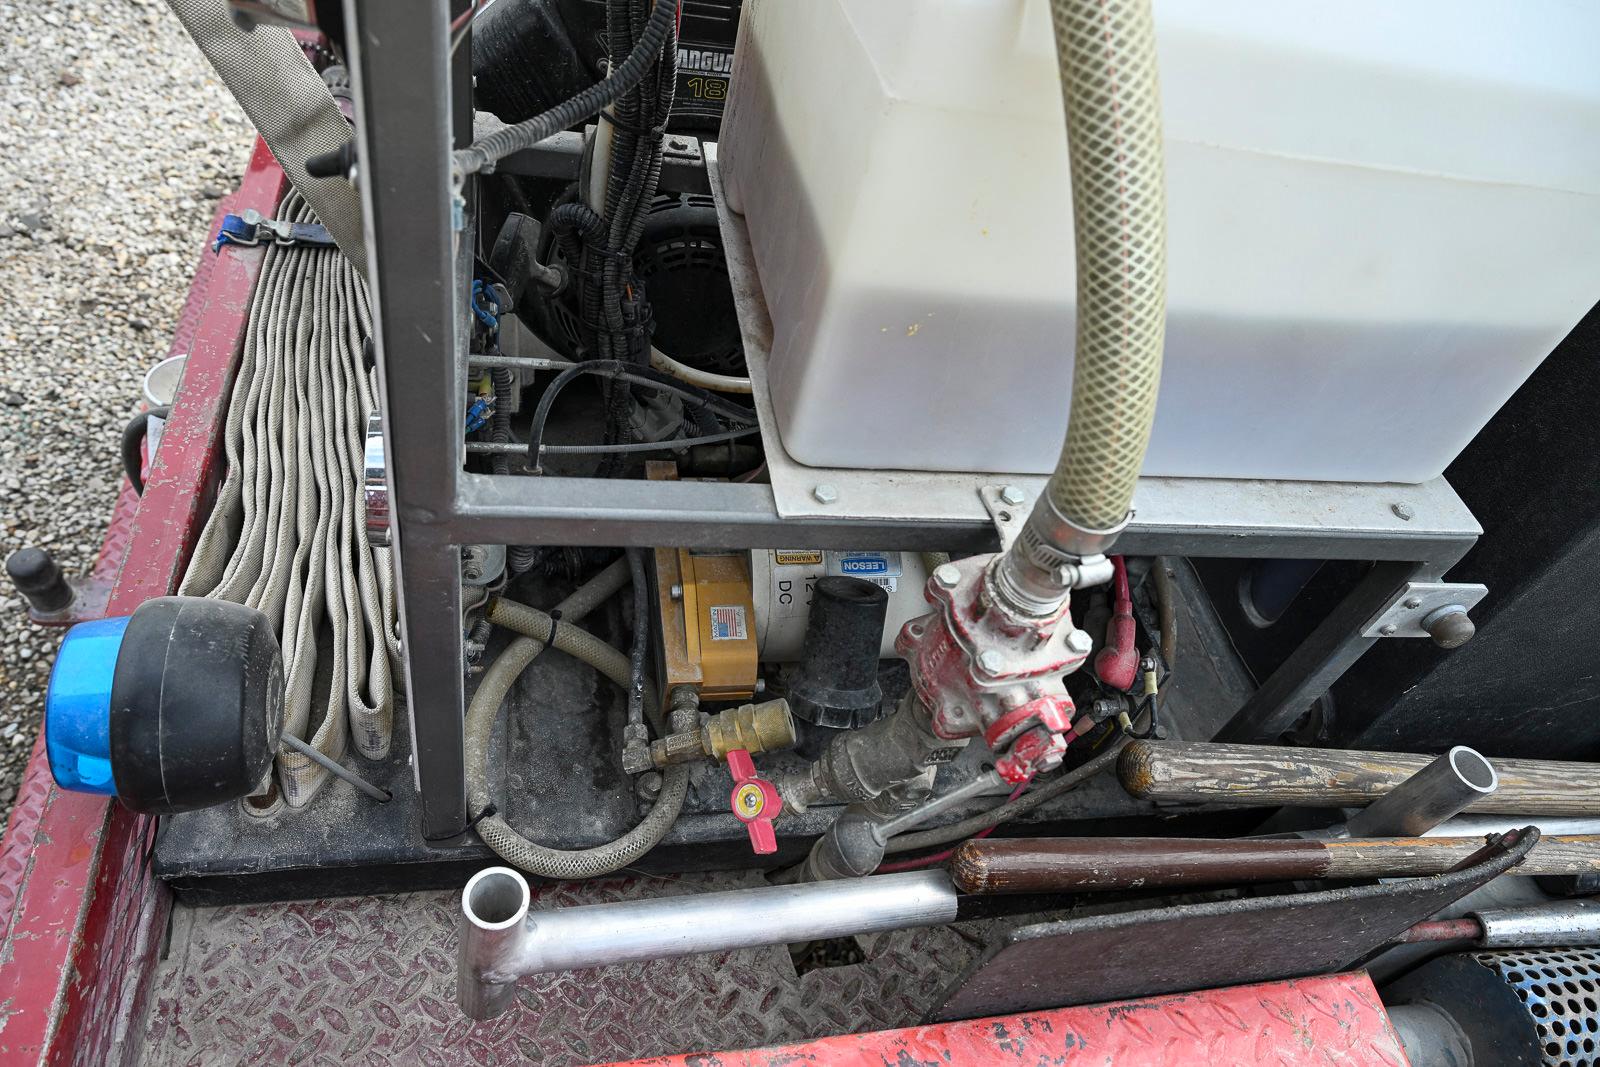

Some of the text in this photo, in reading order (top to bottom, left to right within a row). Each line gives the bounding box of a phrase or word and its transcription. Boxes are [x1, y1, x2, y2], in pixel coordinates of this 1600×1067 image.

[688, 78, 727, 99] 18
[844, 561, 885, 571] LEESON
[779, 580, 793, 605] DC
